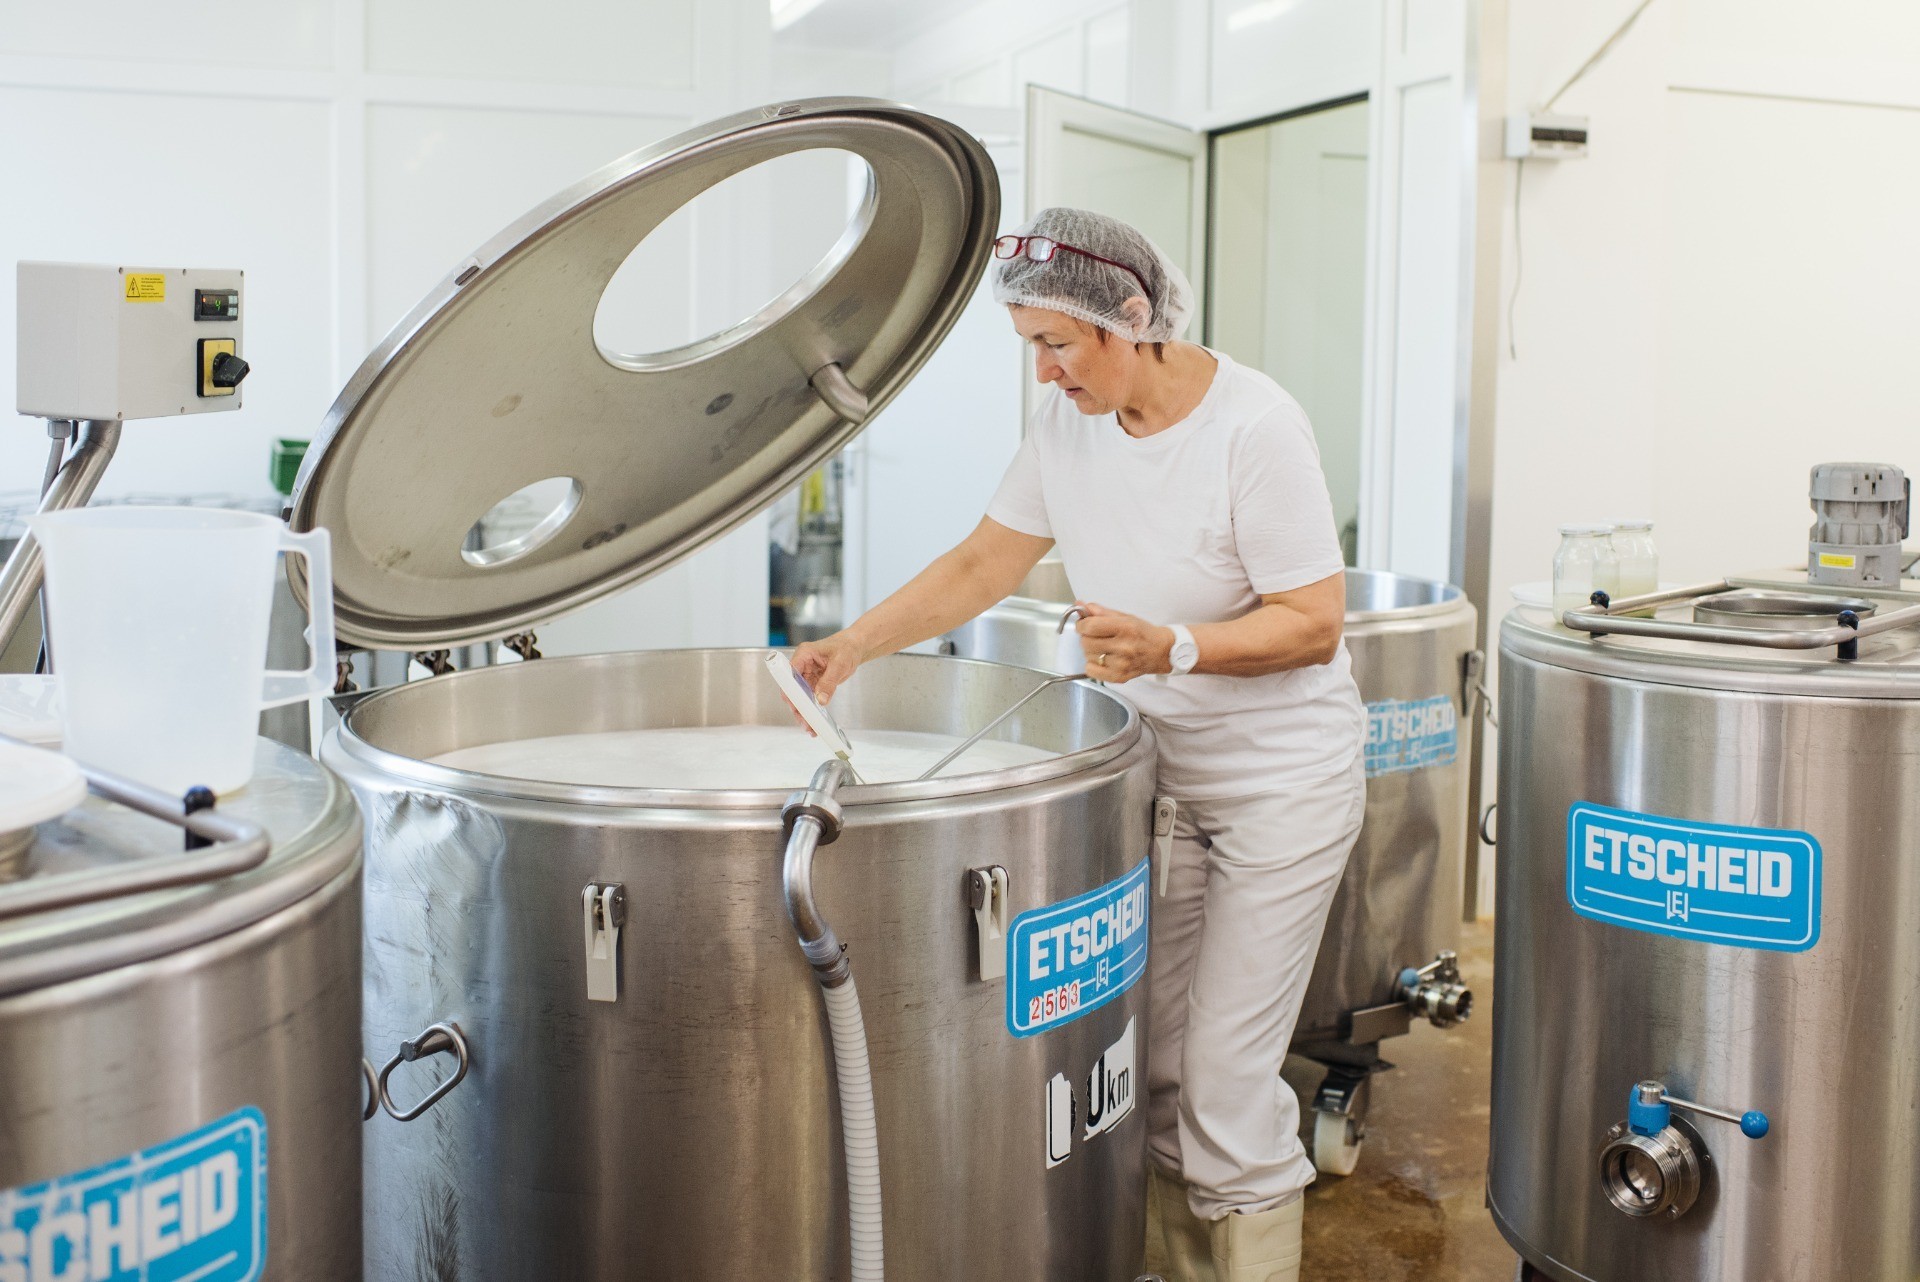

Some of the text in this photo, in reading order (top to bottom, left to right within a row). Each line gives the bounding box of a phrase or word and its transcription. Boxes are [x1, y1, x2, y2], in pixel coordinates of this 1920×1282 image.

[1365, 702, 1455, 743] ETSCHEID
[1585, 824, 1792, 898] ETSCHEID
[1029, 881, 1145, 981] ETSCHEID
[1031, 983, 1078, 1020] 2563
